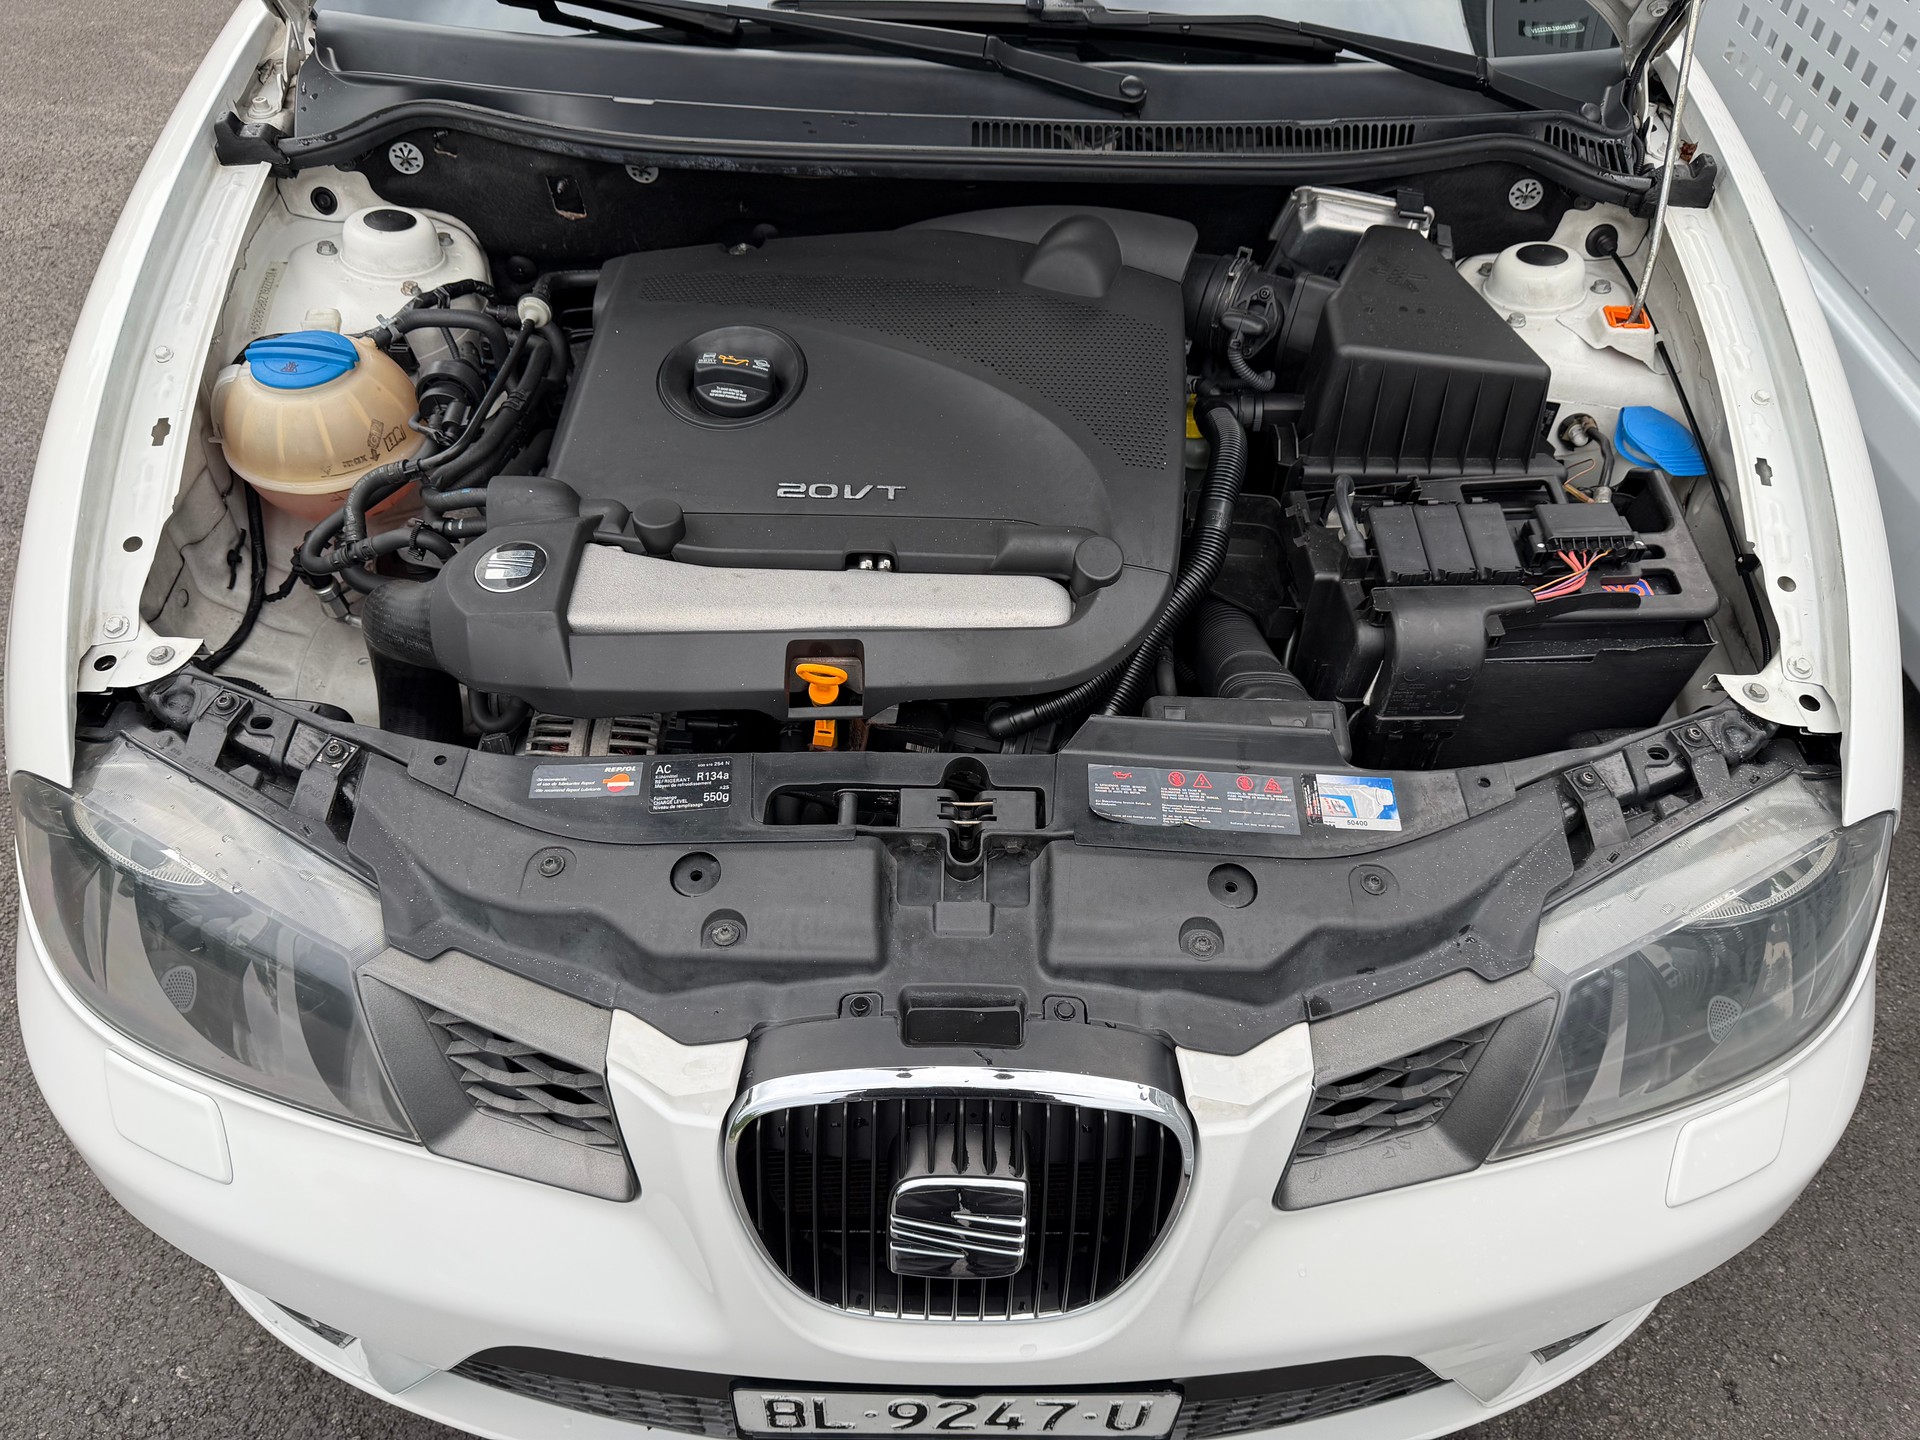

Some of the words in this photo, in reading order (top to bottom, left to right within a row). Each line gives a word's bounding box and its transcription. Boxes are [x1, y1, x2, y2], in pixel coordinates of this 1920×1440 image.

[777, 482, 907, 500] 20VT
[655, 764, 672, 775] AC
[697, 771, 729, 781] R134a
[703, 791, 729, 803] 550g
[765, 1396, 856, 1431] BL
[887, 1397, 1079, 1432] 9247
[1102, 1398, 1155, 1431] U
